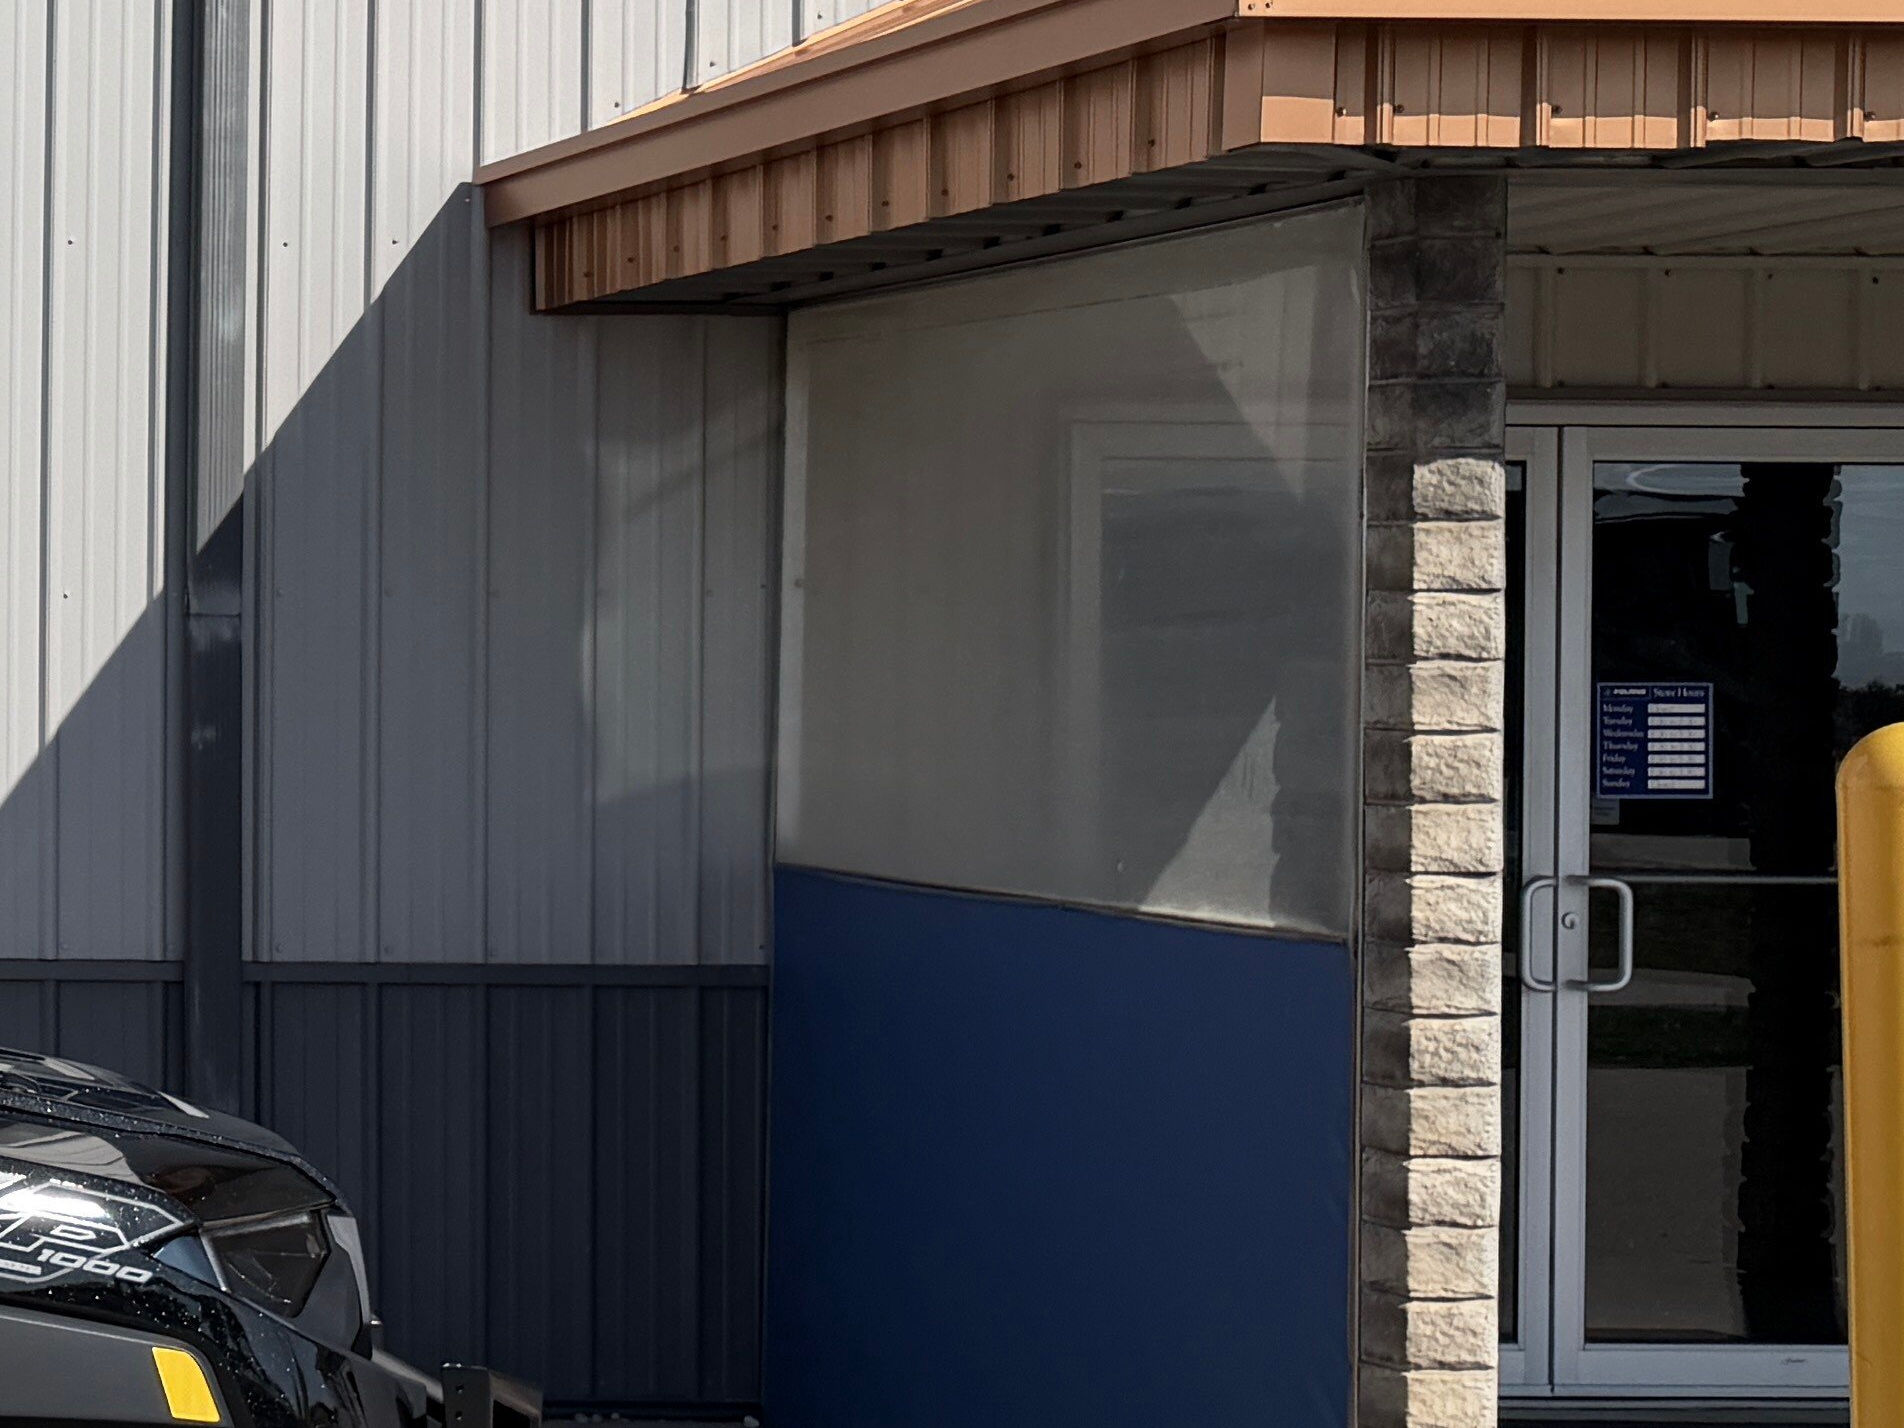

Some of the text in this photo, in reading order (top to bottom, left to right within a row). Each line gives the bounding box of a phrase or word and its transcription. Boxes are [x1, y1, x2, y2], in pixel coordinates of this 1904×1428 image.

[1602, 703, 1634, 714] Monday
[1602, 715, 1633, 727] Tuesday
[1602, 741, 1639, 752] Thursday
[1602, 753, 1627, 764] Friday
[37, 1248, 156, 1284] 1000
